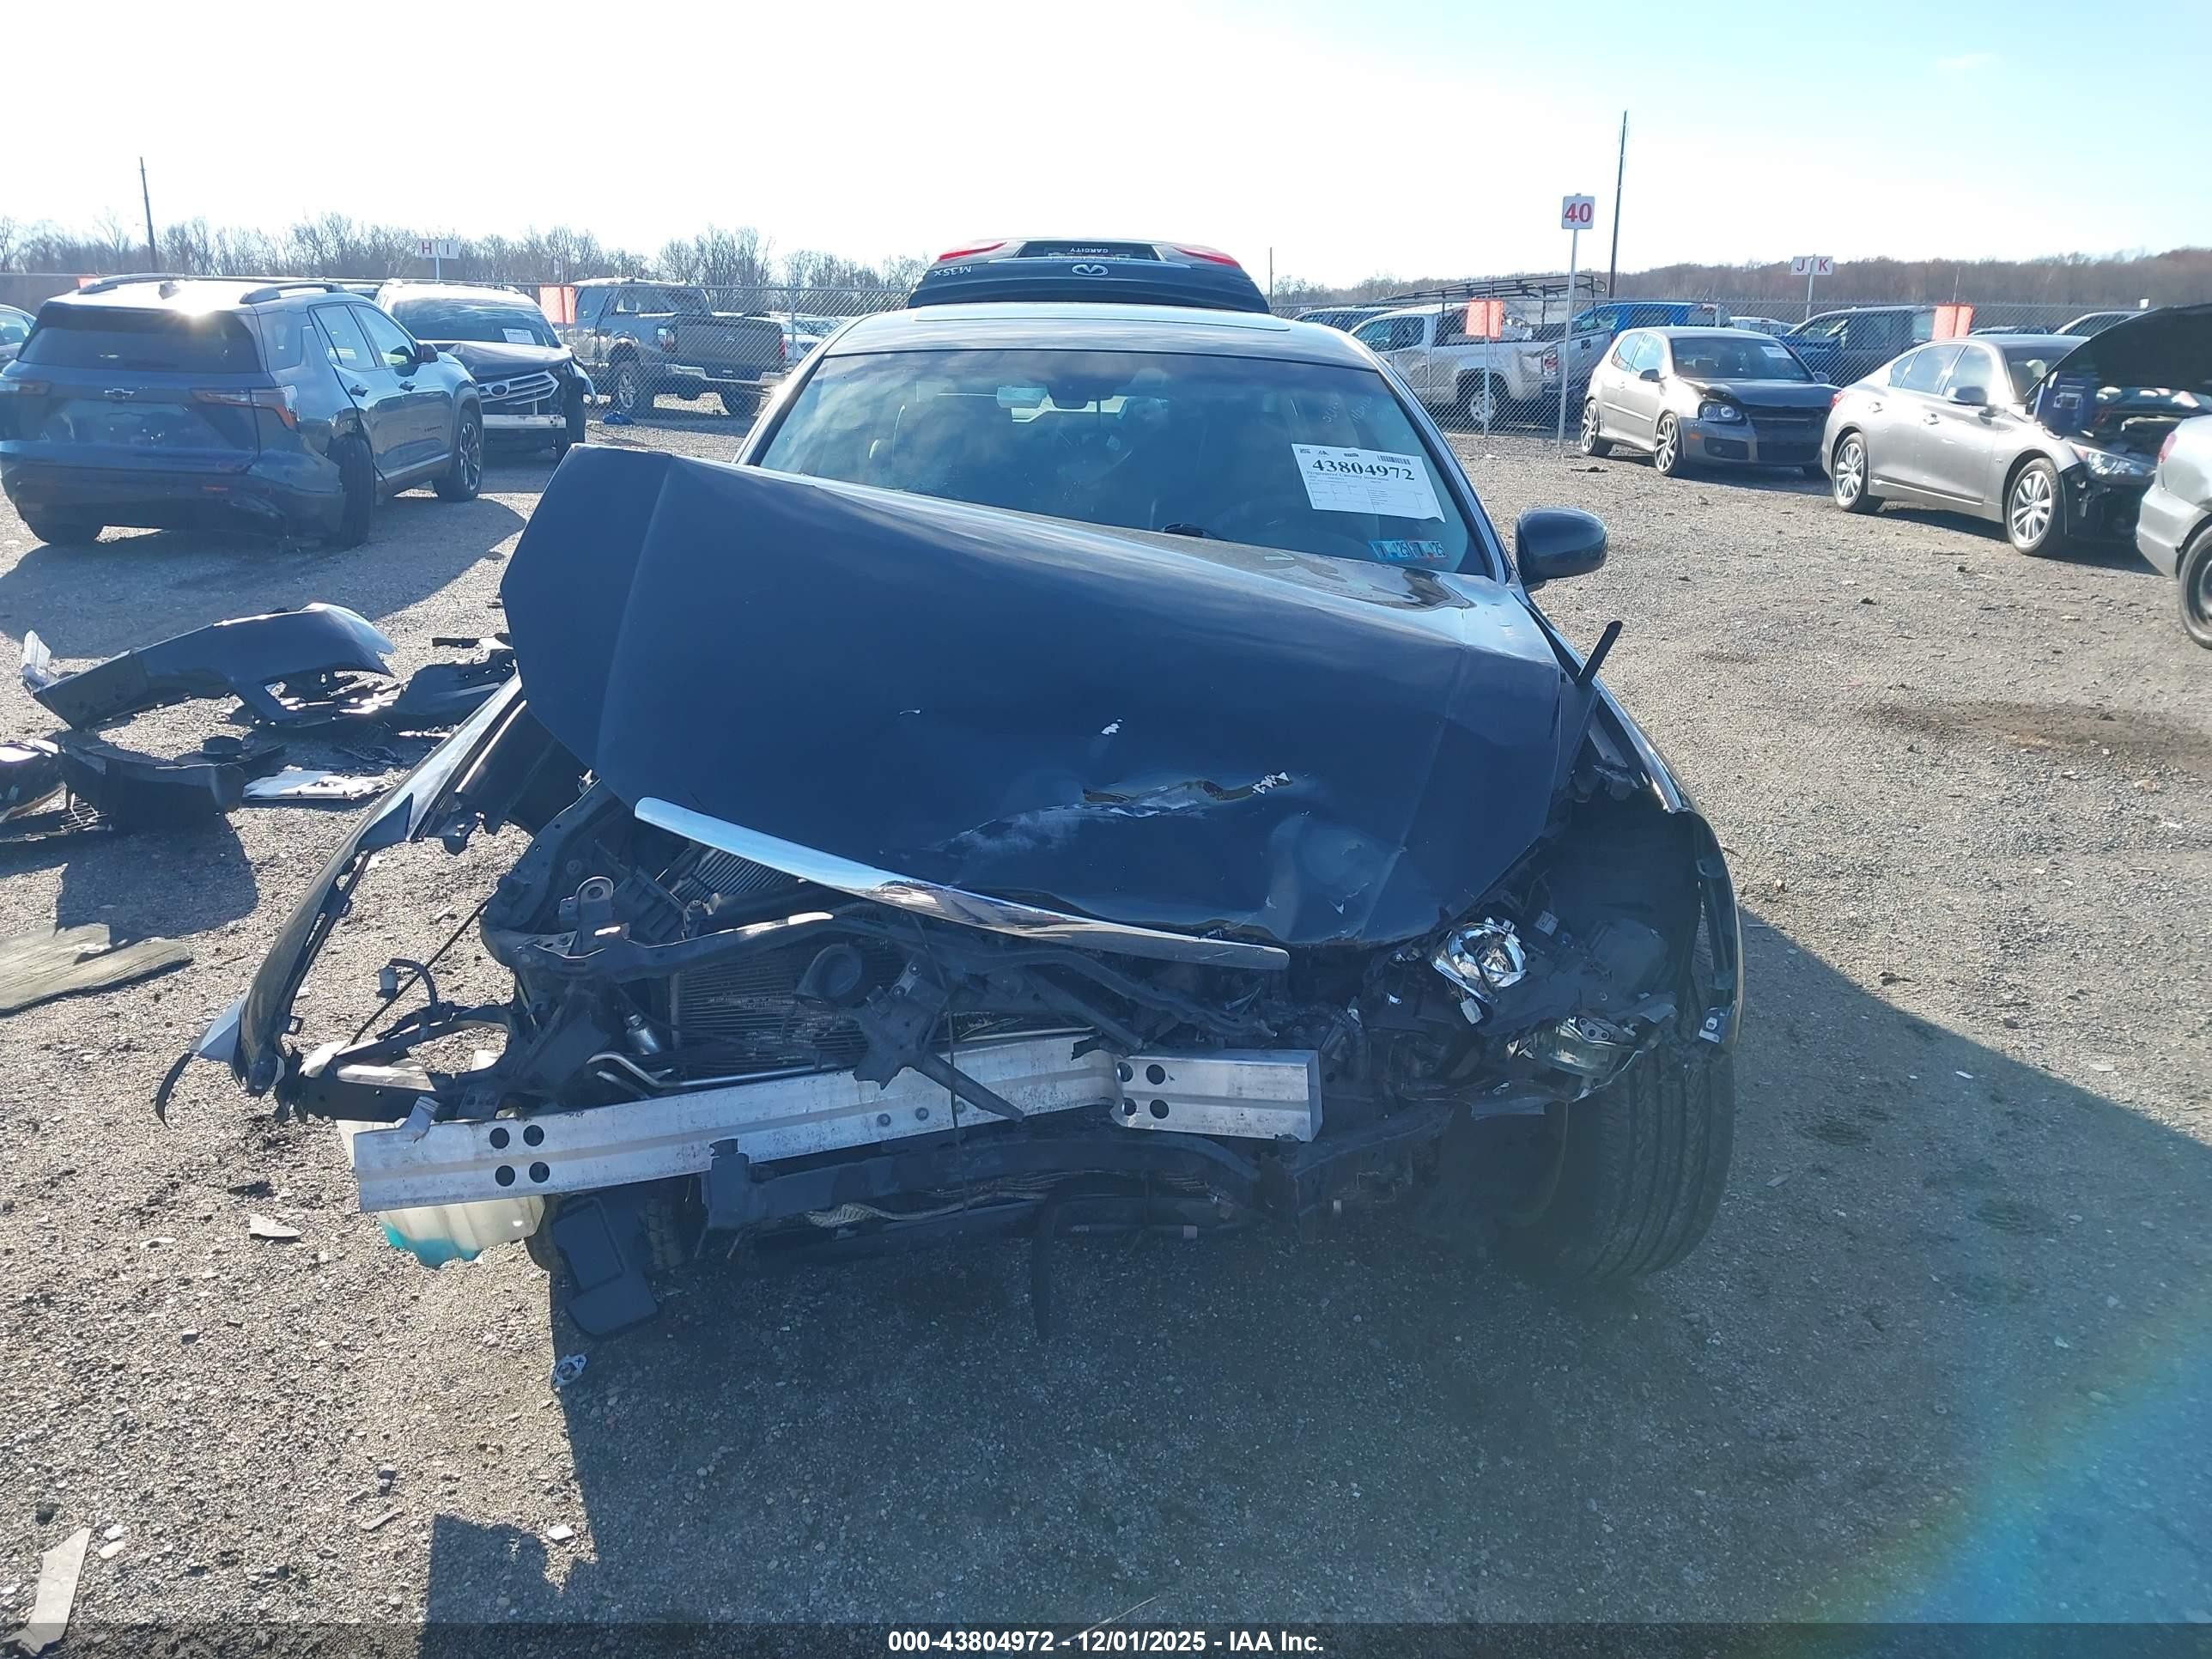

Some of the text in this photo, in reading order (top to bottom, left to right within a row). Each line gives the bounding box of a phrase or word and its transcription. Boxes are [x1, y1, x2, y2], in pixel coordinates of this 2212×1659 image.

[1564, 203, 1593, 223] 40
[421, 241, 432, 255] H
[1796, 258, 1829, 272] J K
[1313, 459, 1415, 481] 43804972
